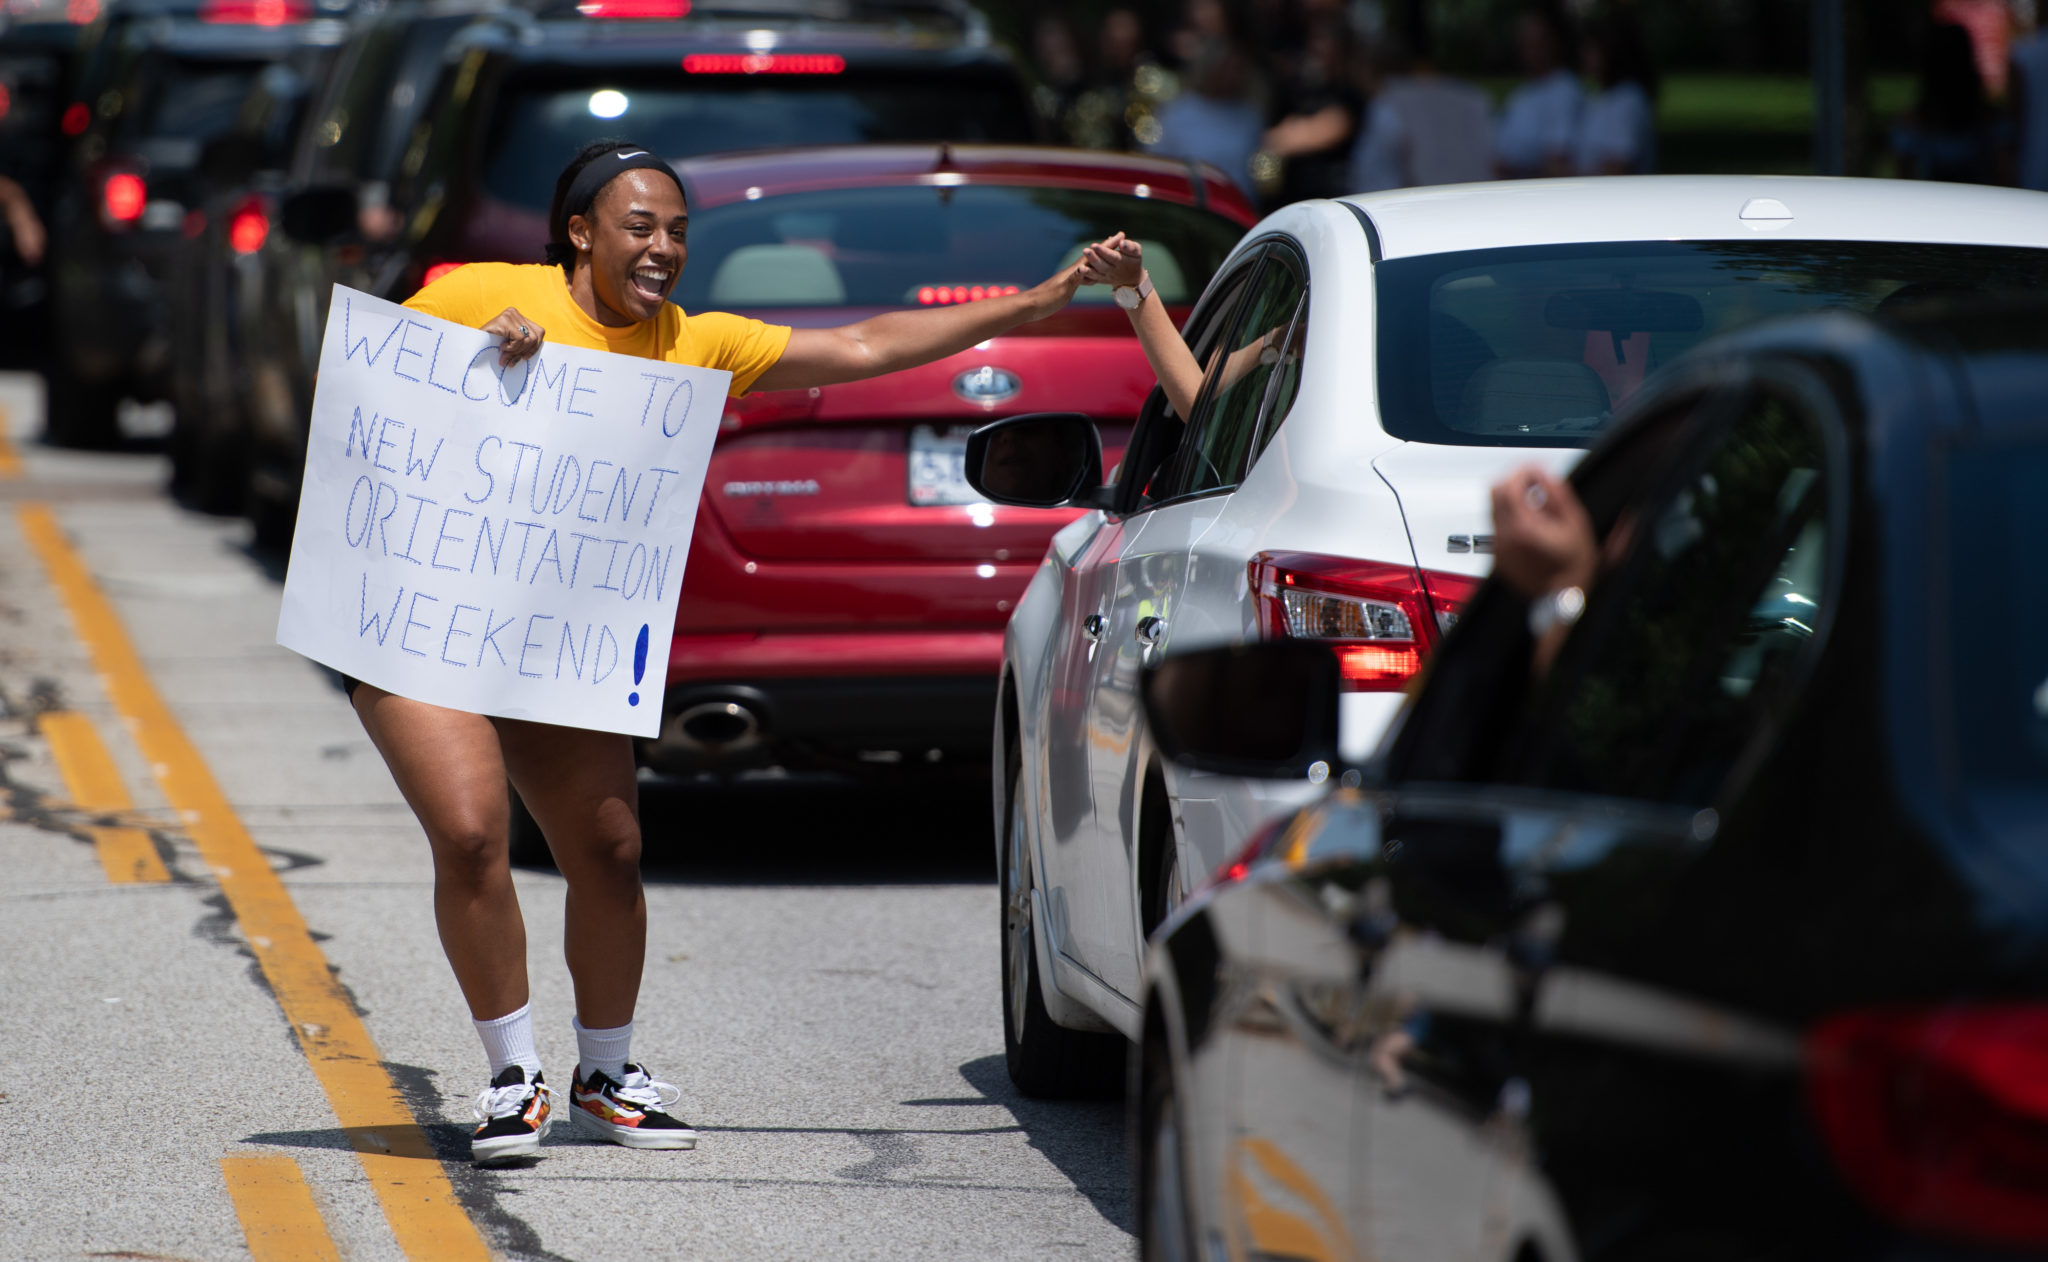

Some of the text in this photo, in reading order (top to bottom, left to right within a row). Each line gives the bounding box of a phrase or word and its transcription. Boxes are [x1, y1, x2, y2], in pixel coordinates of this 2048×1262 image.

[345, 296, 694, 438] WELCOME TO
[345, 405, 680, 528] NEW STUDENT
[345, 475, 673, 602] ORIENTATION
[359, 571, 650, 707] WEEKEND!
